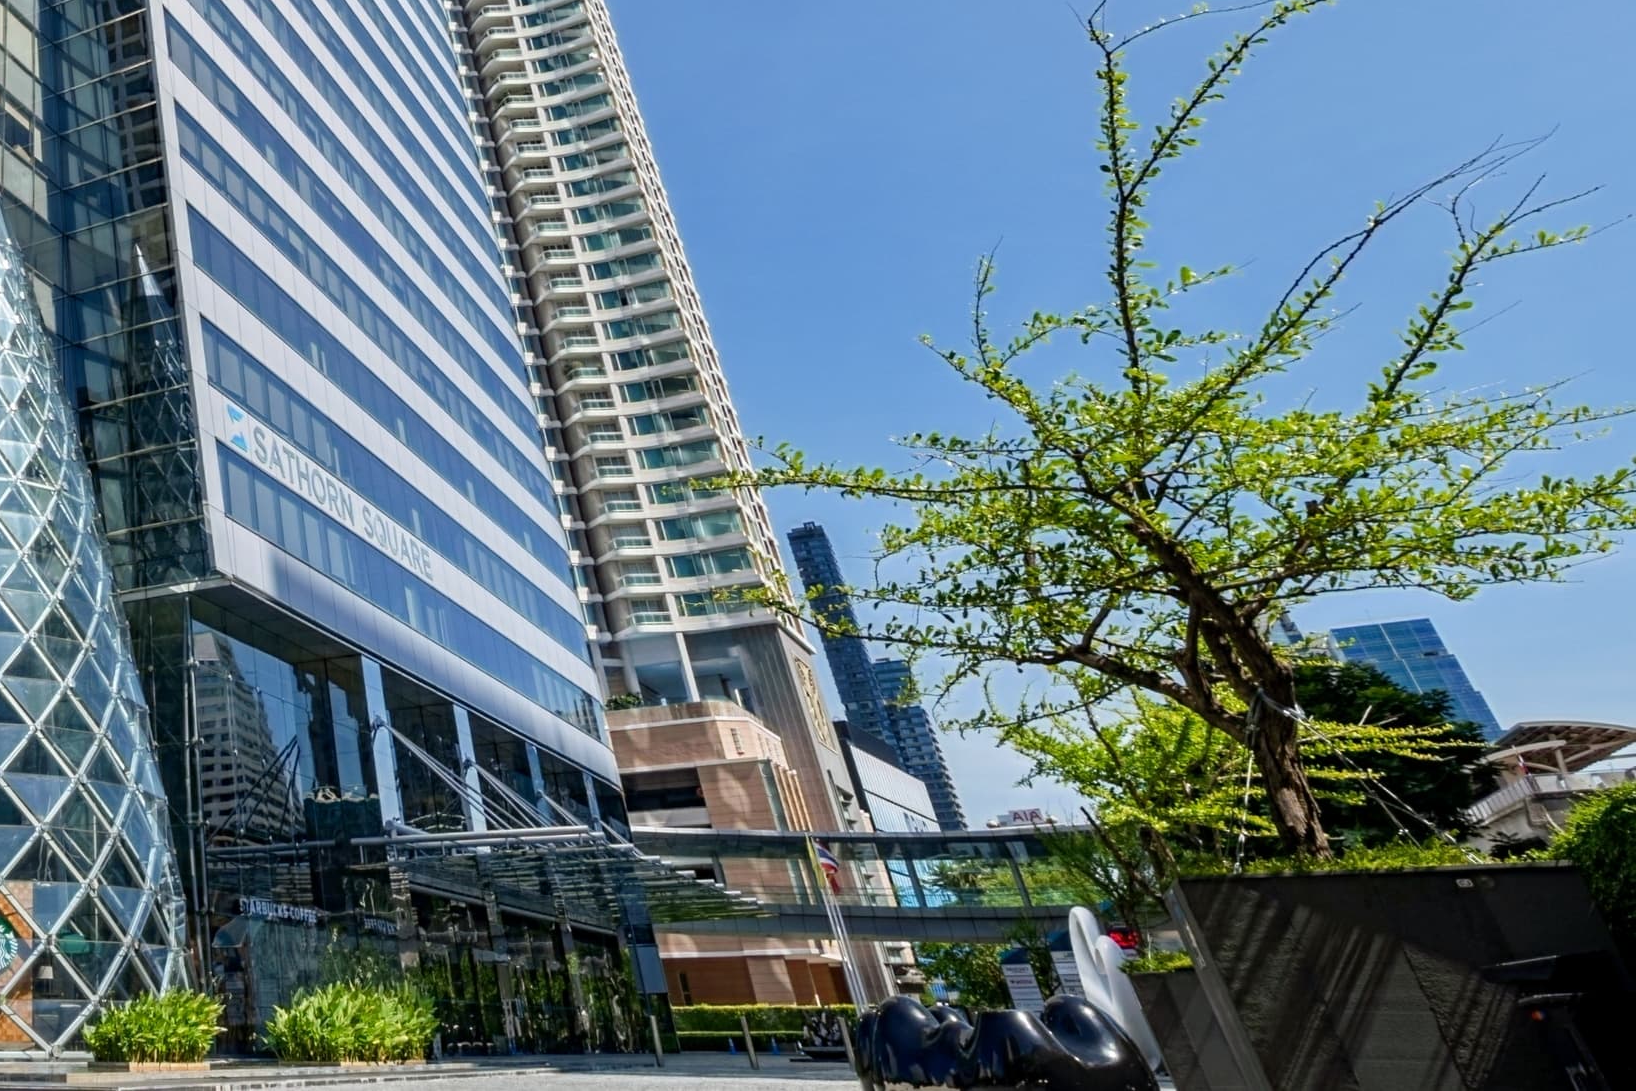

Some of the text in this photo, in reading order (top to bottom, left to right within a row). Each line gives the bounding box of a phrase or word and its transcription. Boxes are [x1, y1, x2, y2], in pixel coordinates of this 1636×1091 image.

[253, 425, 433, 581] SATHORN SQUARE
[1013, 810, 1042, 822] AIA
[239, 897, 317, 923] STARBUCKS COFFEE
